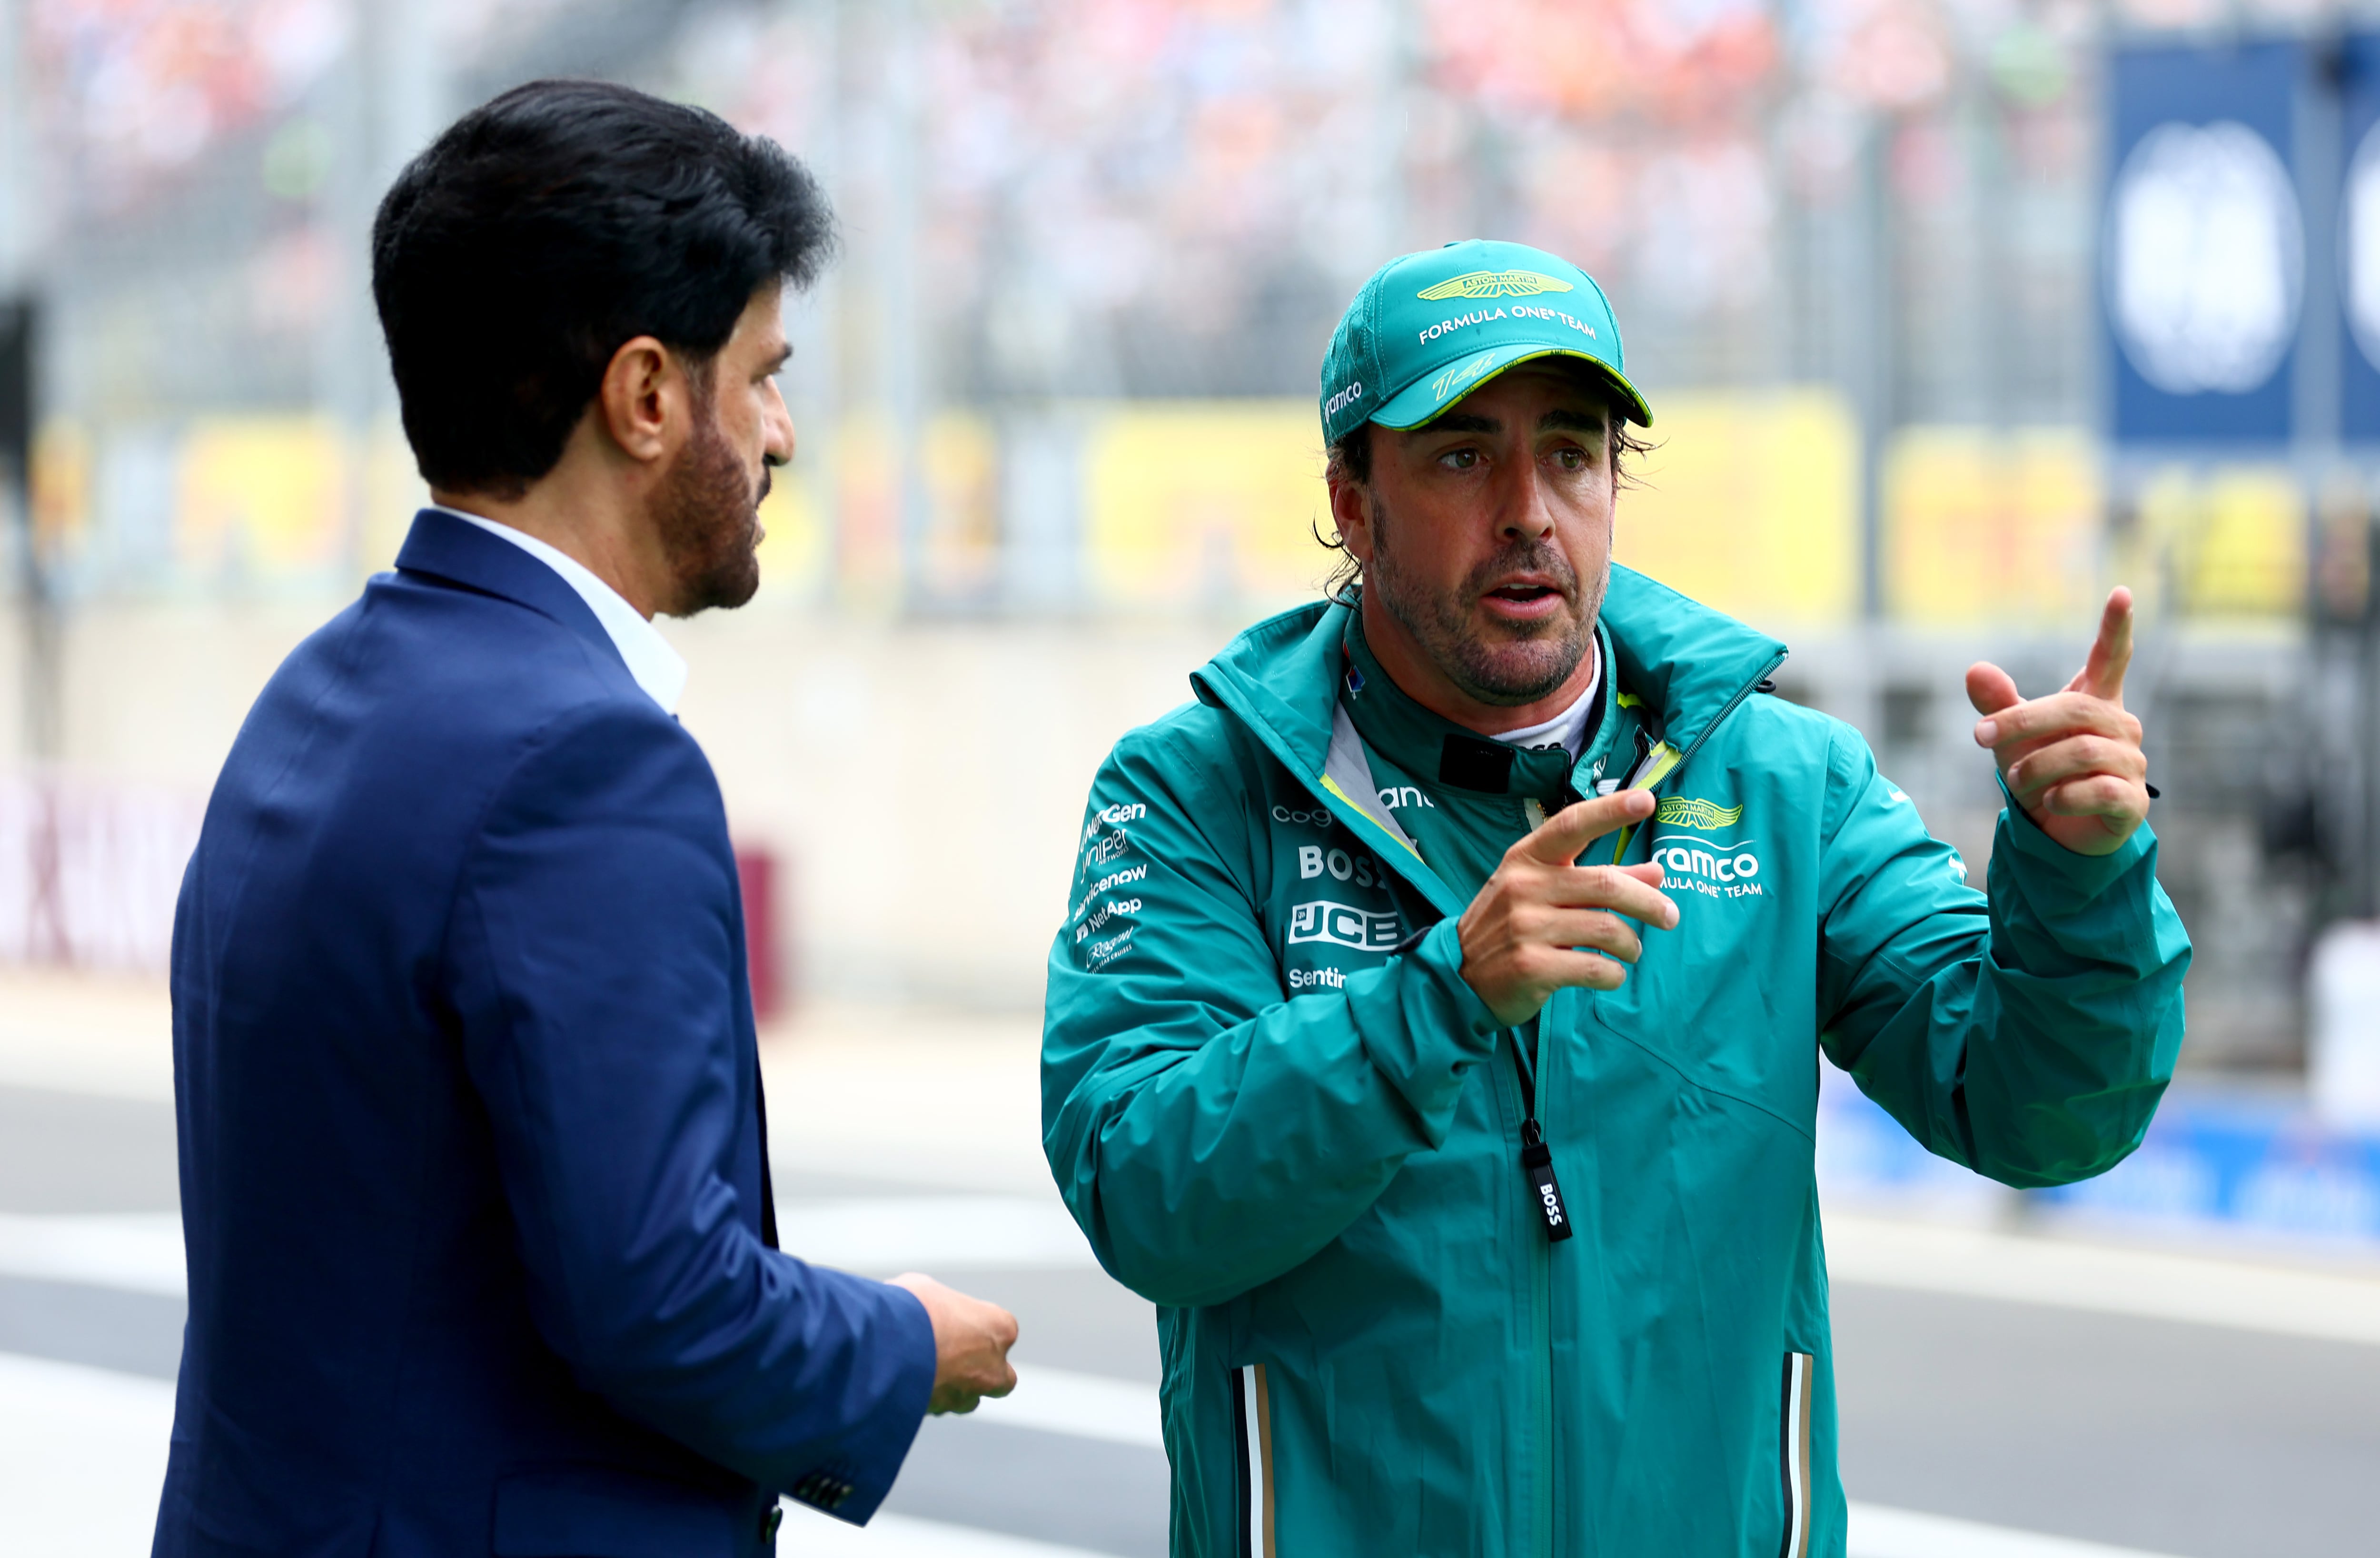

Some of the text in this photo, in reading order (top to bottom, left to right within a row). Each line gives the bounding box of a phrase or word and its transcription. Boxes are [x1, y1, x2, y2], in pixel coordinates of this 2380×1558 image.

[1466, 275, 1536, 288] ASTON MARTIN
[1419, 307, 1507, 345] FORMULA
[1557, 311, 1596, 340] TEAM
[1662, 803, 1713, 817] ASTON MARTIN
[1099, 844, 1129, 866] NETWORKS
[1724, 883, 1762, 898] TEAM
[1088, 898, 1142, 933] NetApp
[1111, 943, 1132, 960] CRUISES
[1540, 1183, 1562, 1226] BOSS
